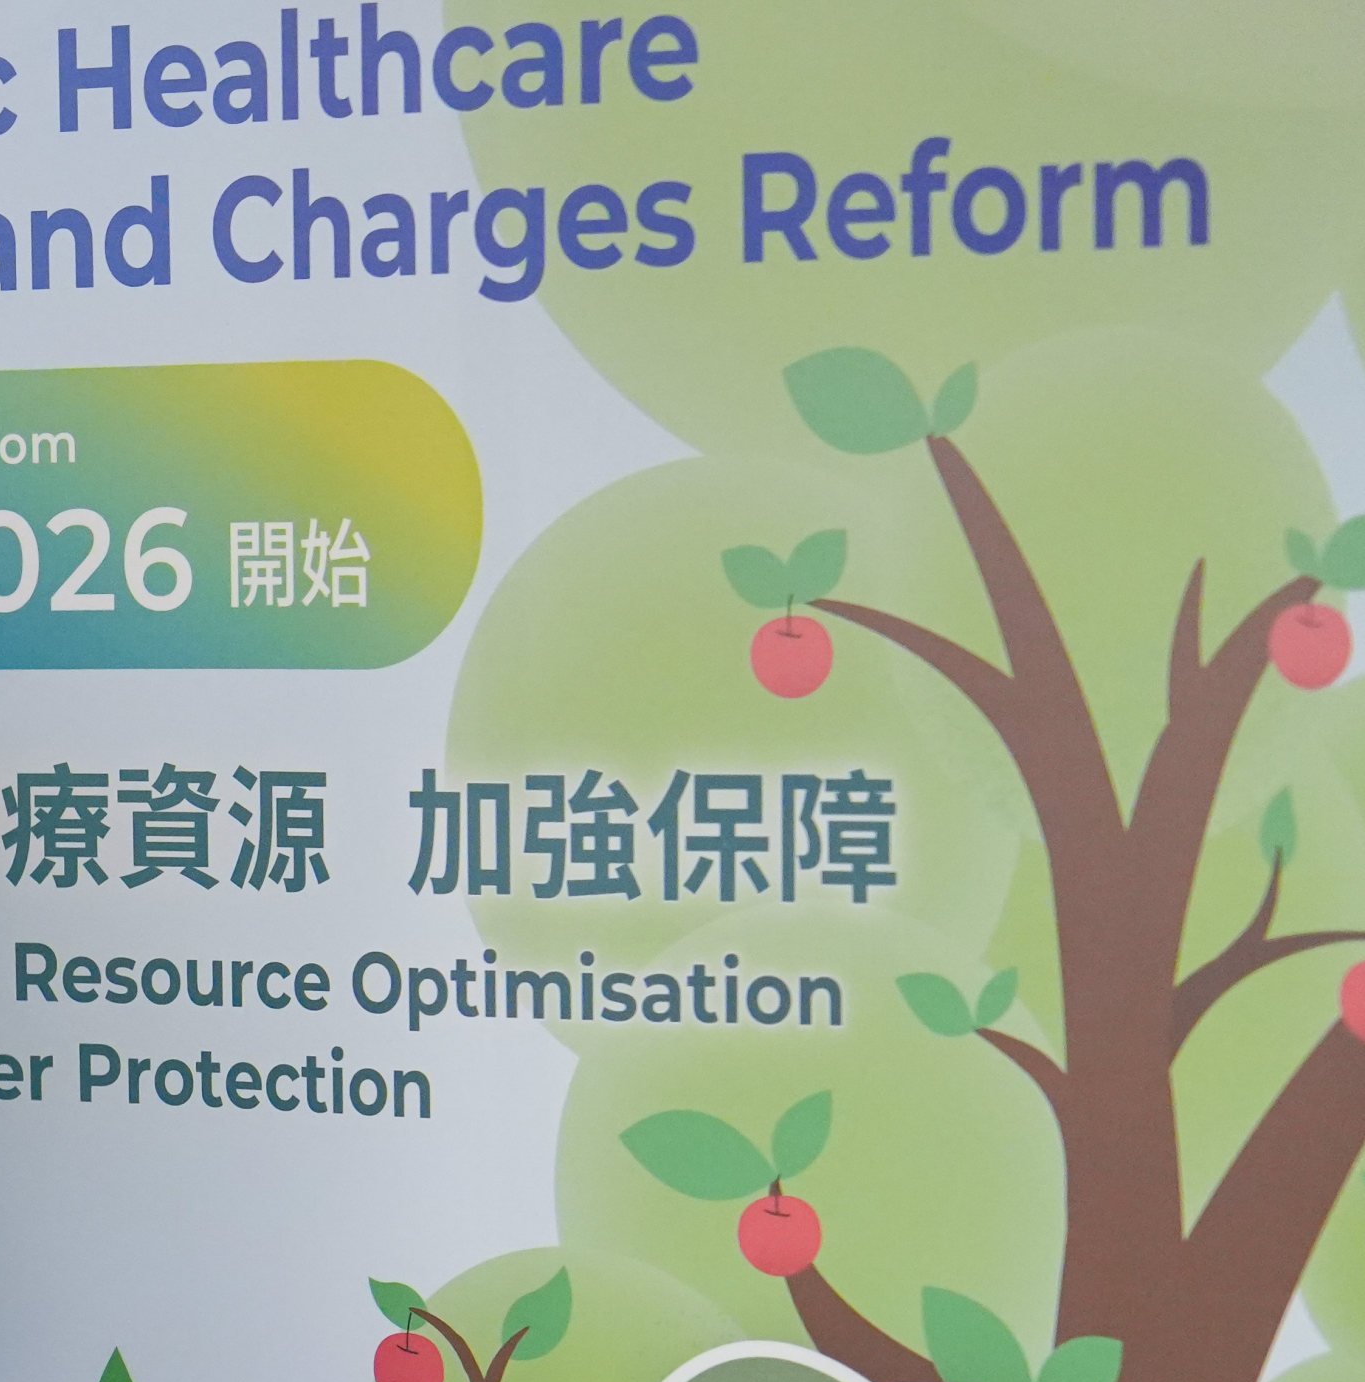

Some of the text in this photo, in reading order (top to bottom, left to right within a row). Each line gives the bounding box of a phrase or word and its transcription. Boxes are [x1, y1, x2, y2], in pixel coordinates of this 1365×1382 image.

[57, 2, 700, 133] Healthcare
[212, 167, 697, 303] Charges
[741, 135, 1212, 264] Reform
[229, 518, 371, 609] 開始
[408, 767, 898, 905] 加強保障
[14, 942, 331, 1012] Resource
[352, 948, 843, 1032] Optimisation
[78, 1044, 432, 1120] Protection
